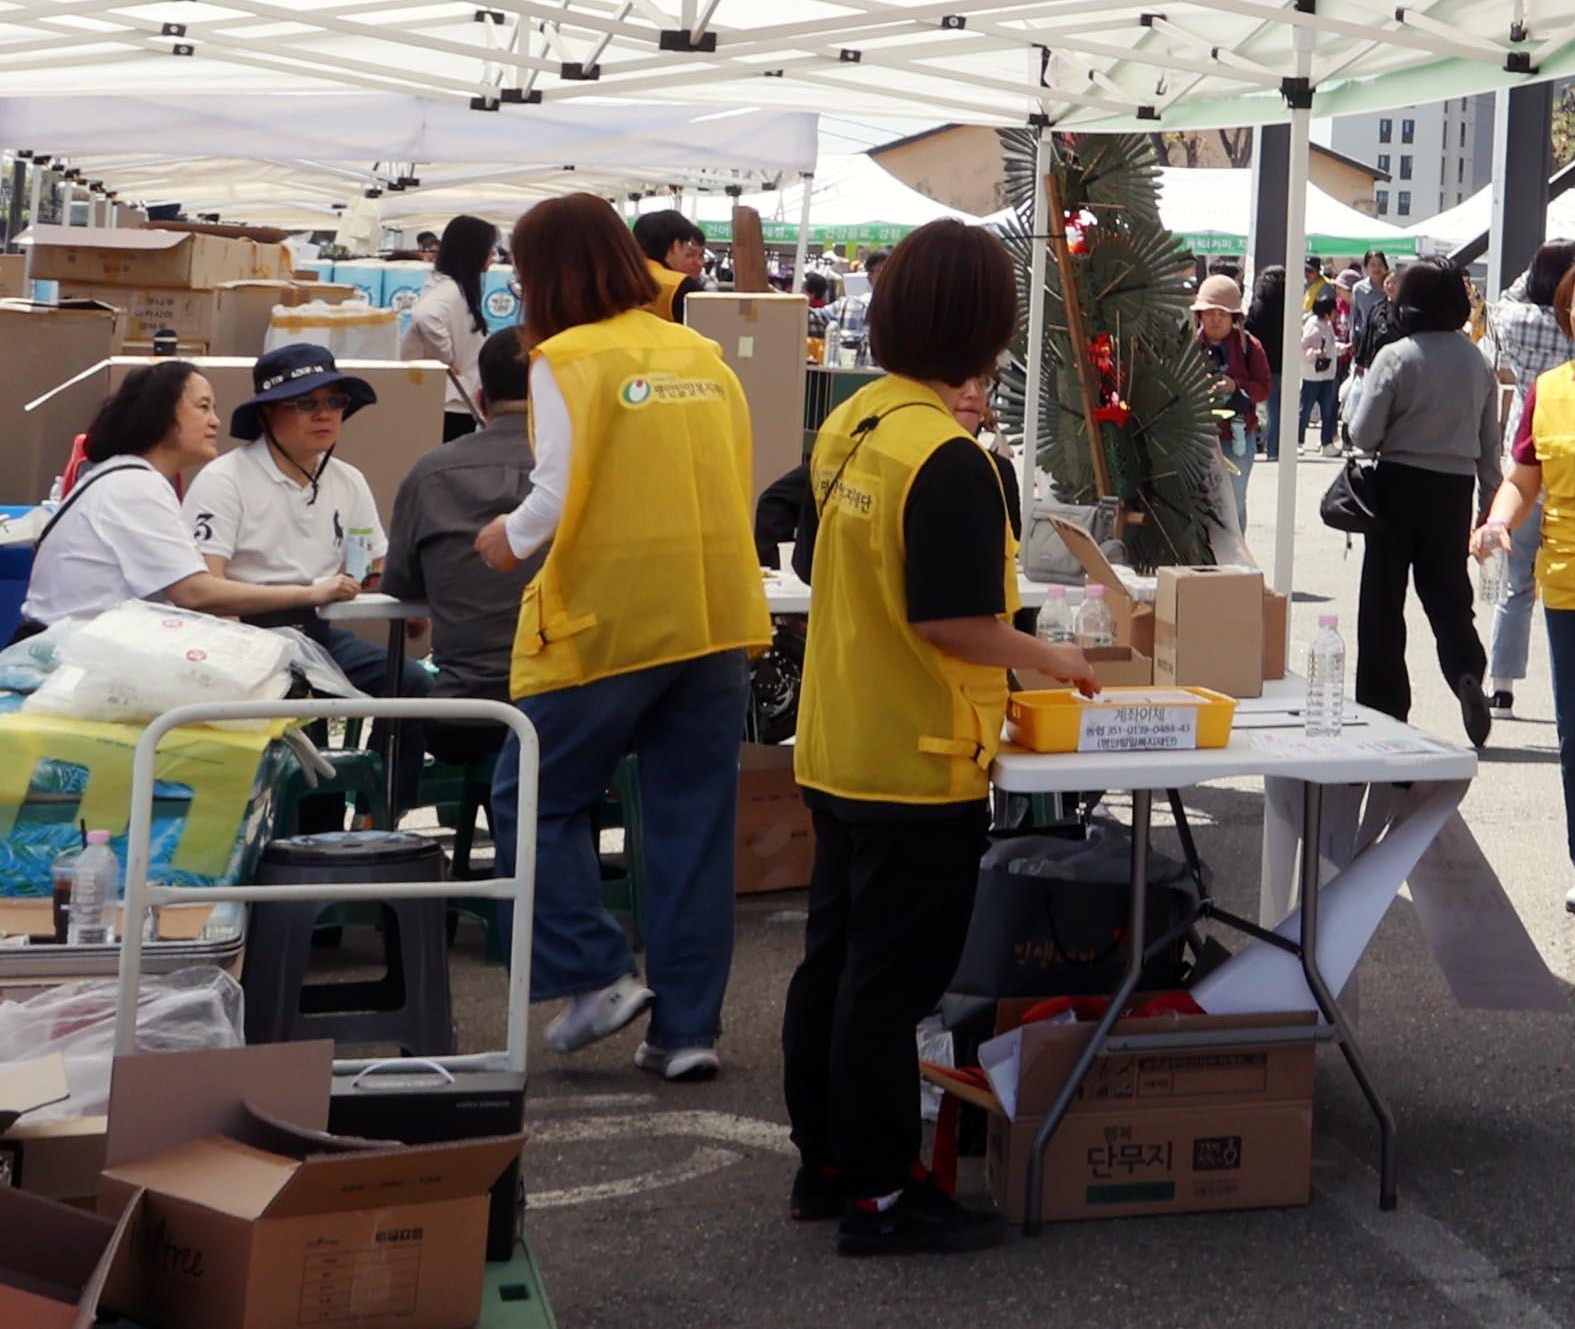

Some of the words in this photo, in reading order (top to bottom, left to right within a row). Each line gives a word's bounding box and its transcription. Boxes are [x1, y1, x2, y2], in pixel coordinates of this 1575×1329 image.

[193, 513, 214, 541] 3
[1114, 707, 1166, 722] 계좌이체
[1086, 726, 1105, 736] 농협
[1087, 1140, 1173, 1178] 단무지
